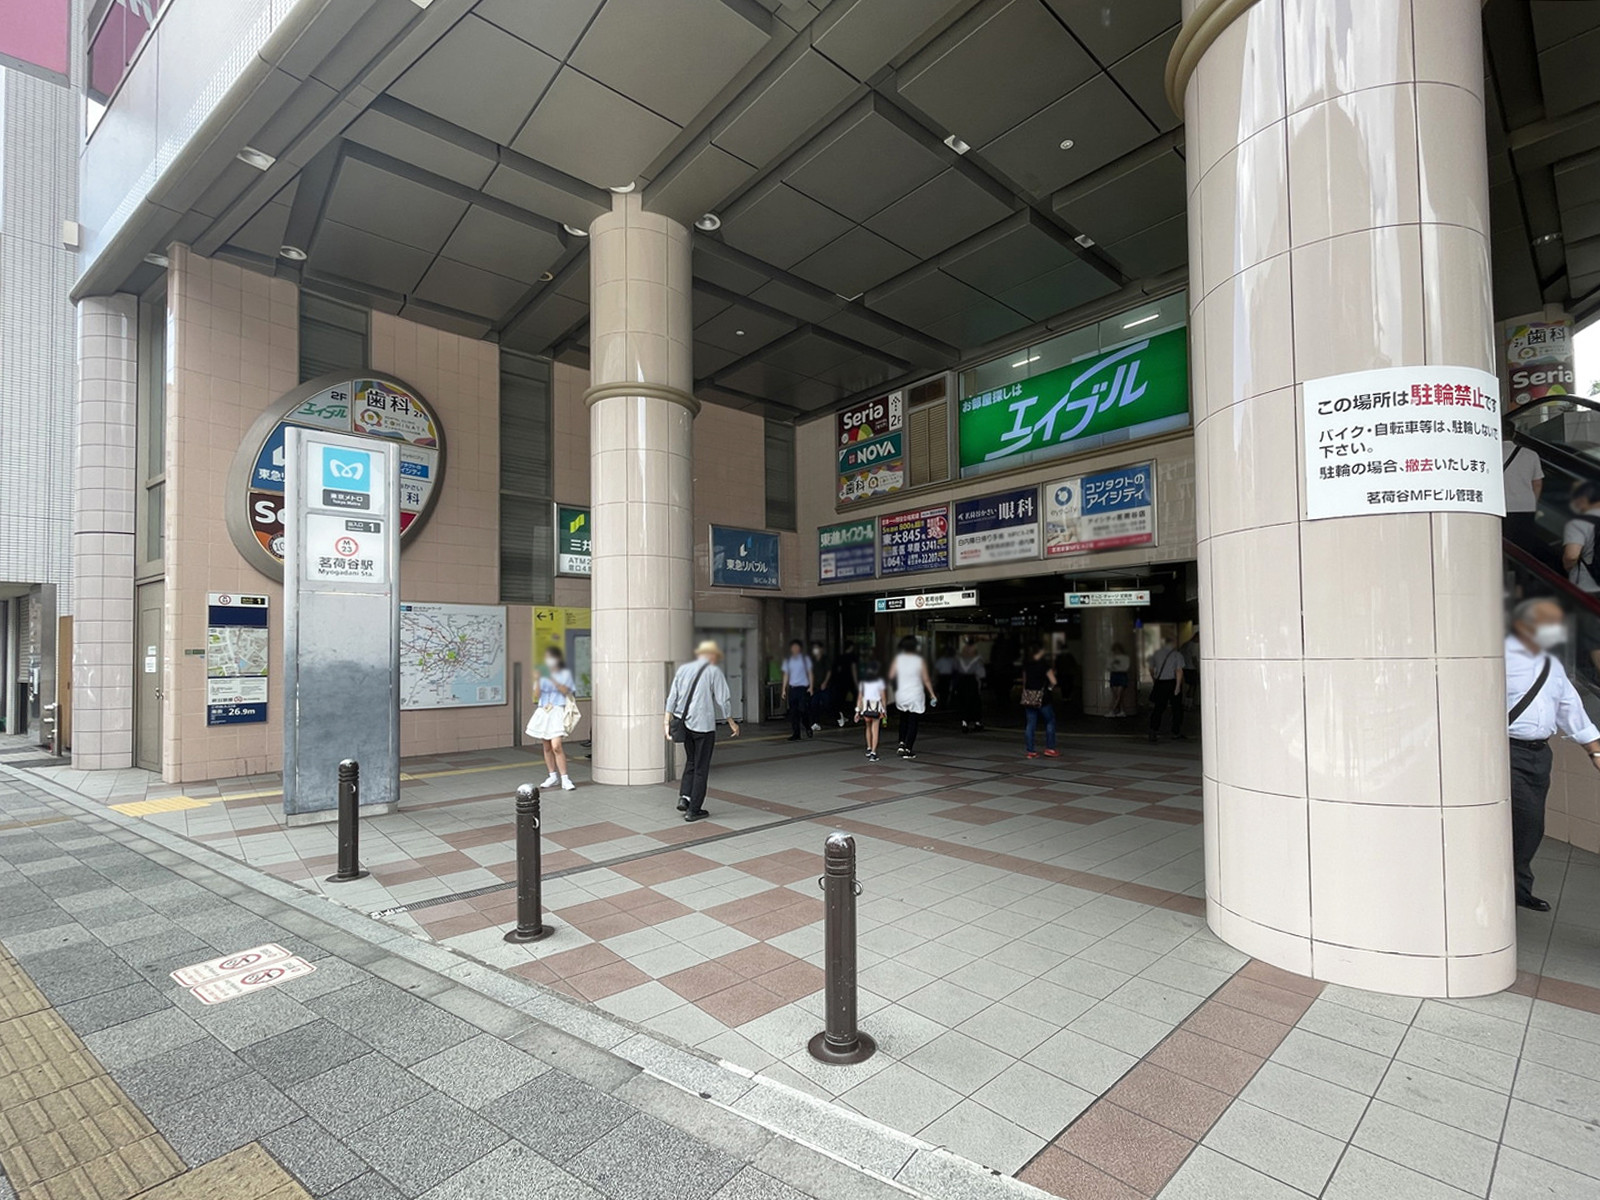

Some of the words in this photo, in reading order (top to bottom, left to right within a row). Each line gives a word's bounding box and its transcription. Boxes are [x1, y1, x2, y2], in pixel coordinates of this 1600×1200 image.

[1528, 327, 1565, 345] 歯科
[1512, 365, 1574, 389] Seria
[331, 391, 347, 401] 2F
[366, 389, 410, 416] 歯科
[961, 383, 1023, 413] お部屋探しは
[984, 339, 1150, 461] エイブル
[1318, 383, 1497, 416] この場所は駐輪禁止です
[297, 402, 349, 419] エイブル
[843, 402, 884, 430] Seria
[890, 414, 902, 427] 2F
[1319, 420, 1499, 443] バイク・自転車等は、駐輪しないで
[857, 441, 895, 464] NOVA
[1319, 443, 1373, 459] 下さい。
[1319, 459, 1490, 480] 駐輪の場合、撤去いたします。
[1086, 473, 1145, 494] コンタクトの
[1086, 488, 1145, 509] アイシティ
[1367, 489, 1484, 504] 茗荷谷MFビル管理者
[998, 497, 1034, 521] 眼科
[369, 523, 375, 532] 1
[820, 525, 874, 547] 東進ハイスクール
[318, 569, 360, 577] Myogadani
[319, 557, 374, 571] 茗荷谷駅
[726, 559, 768, 573] 東急リバブル
[549, 612, 554, 621] 1
[228, 708, 256, 716] 26.9m
